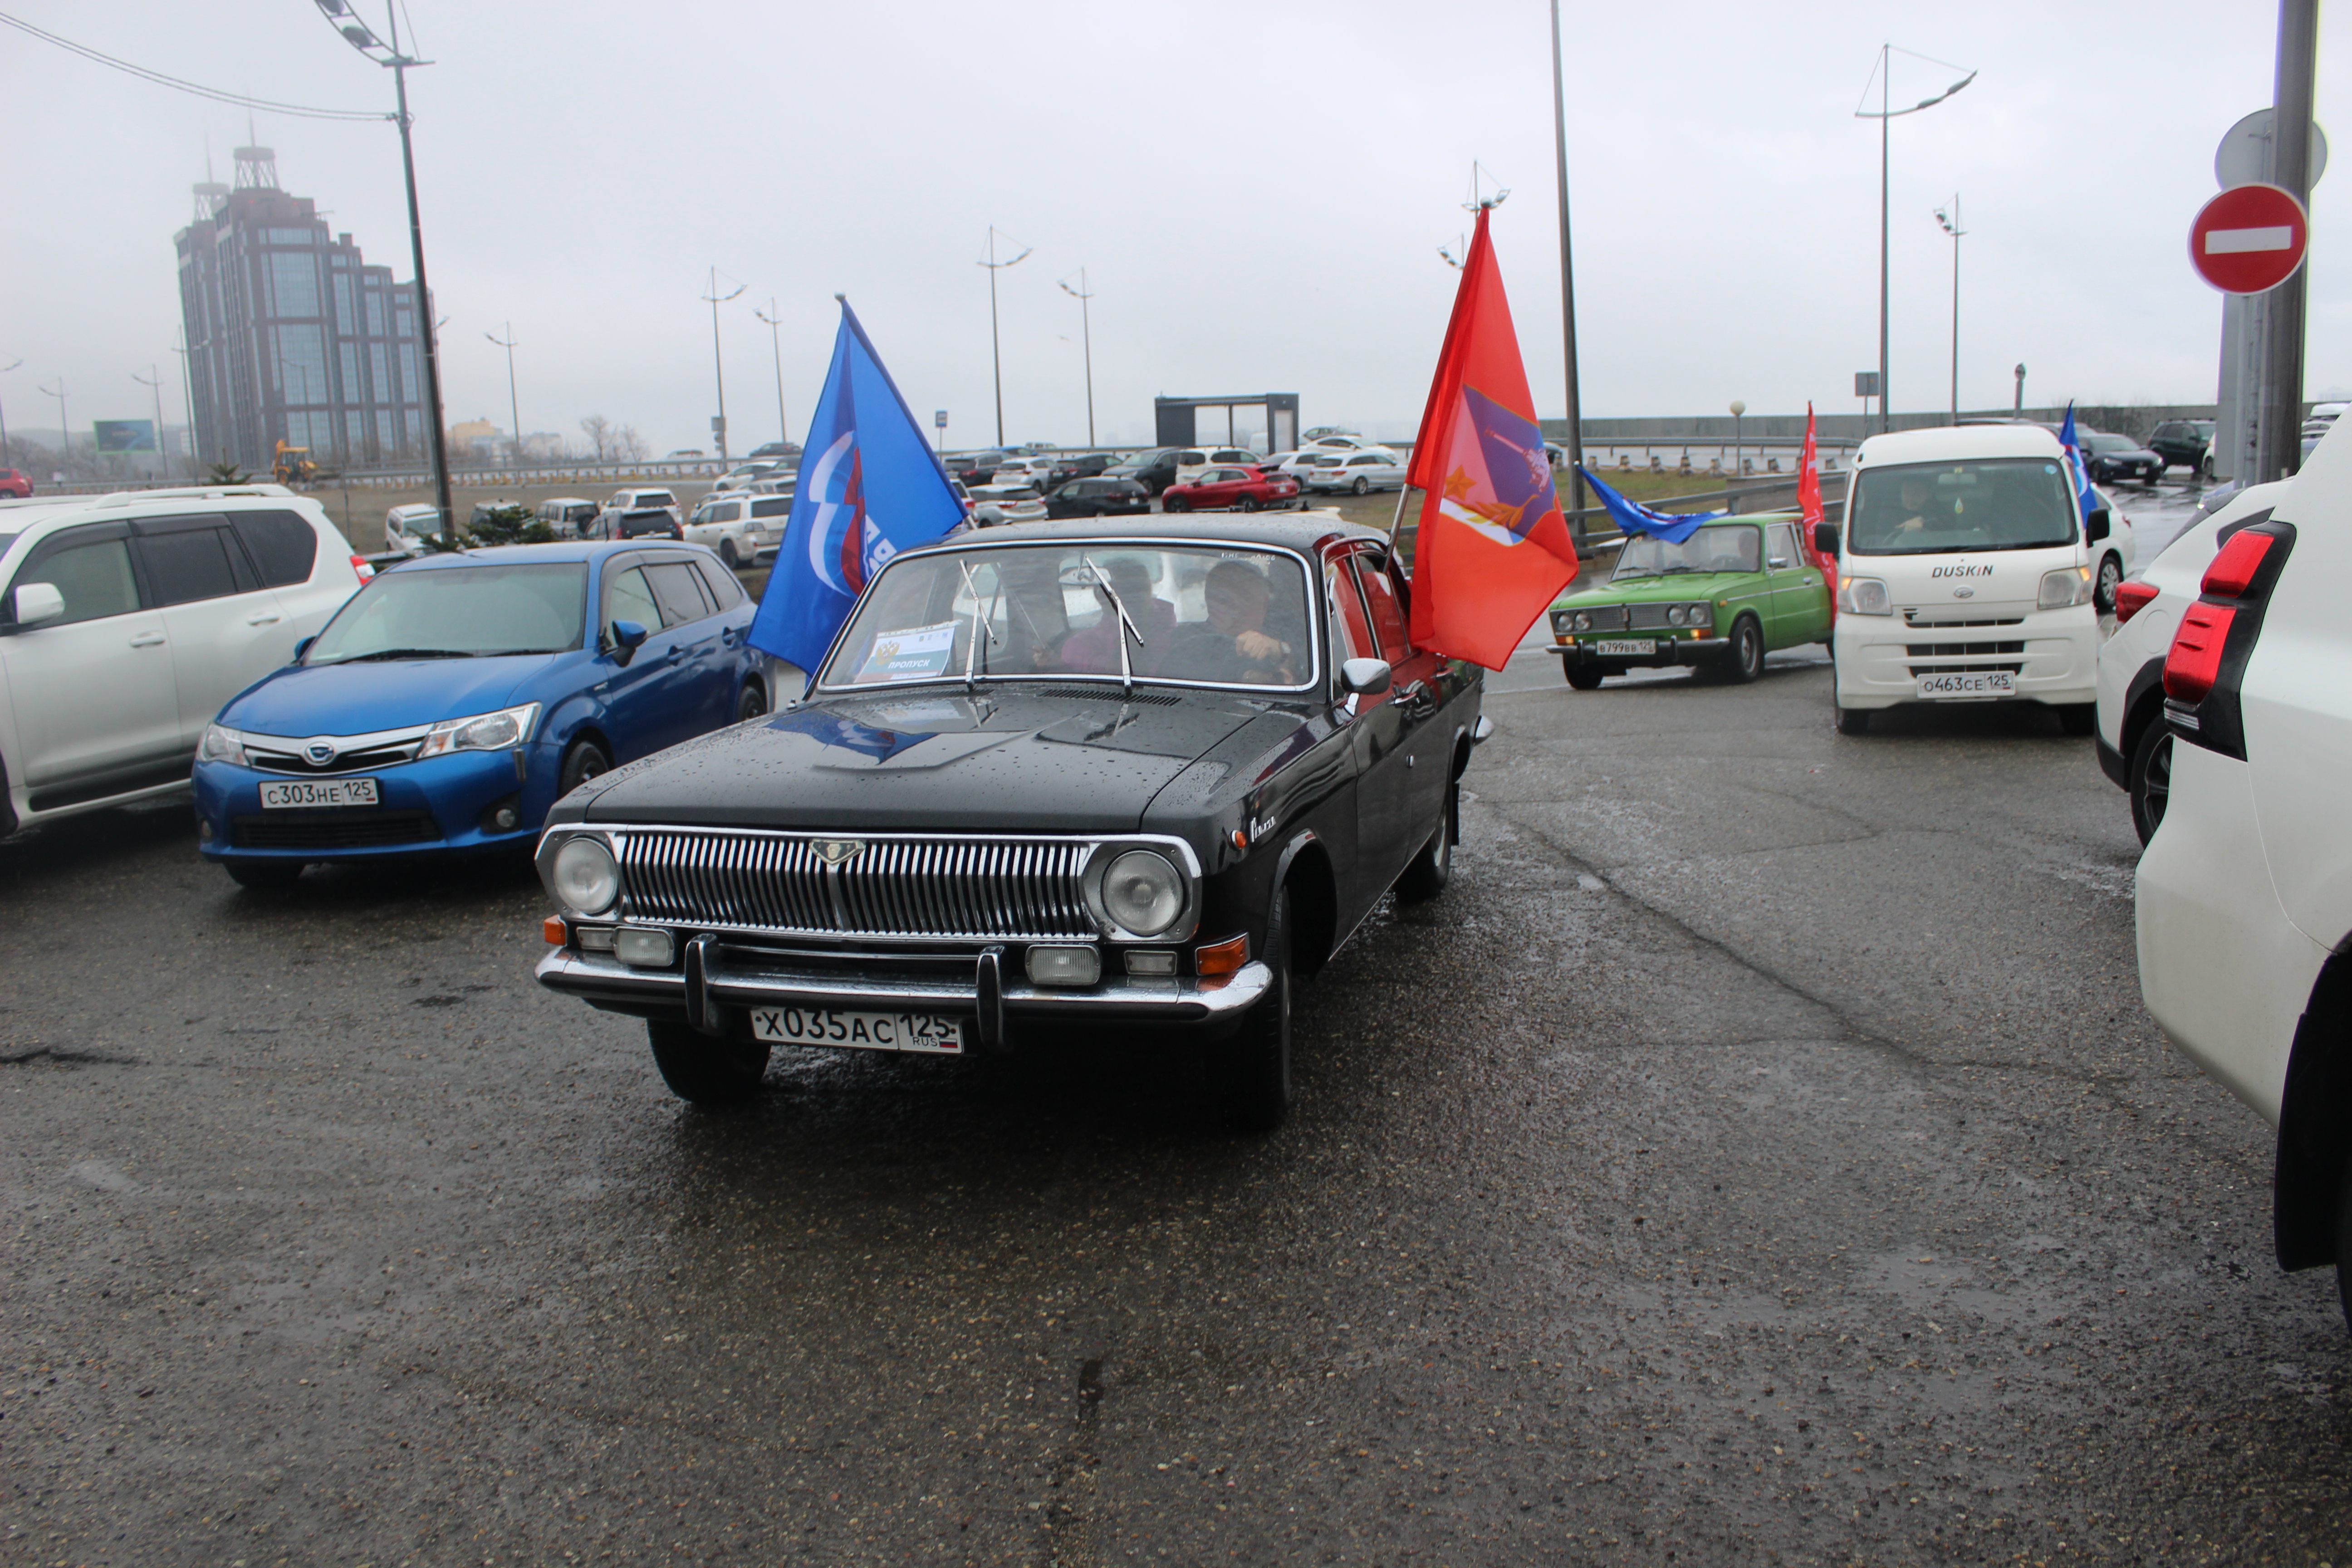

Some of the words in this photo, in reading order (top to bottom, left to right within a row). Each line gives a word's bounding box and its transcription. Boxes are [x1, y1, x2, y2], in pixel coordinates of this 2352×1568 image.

[1932, 564, 1994, 578] DUSKIN
[888, 659, 930, 669] ПРОПУСК
[1924, 676, 1983, 691] О463СЕ
[1987, 675, 2009, 686] 125
[268, 784, 340, 804] С303НЕ
[344, 781, 371, 796] 125
[762, 1007, 893, 1044] Х035АС
[899, 1014, 950, 1039] 125
[913, 1037, 938, 1046] RUS
